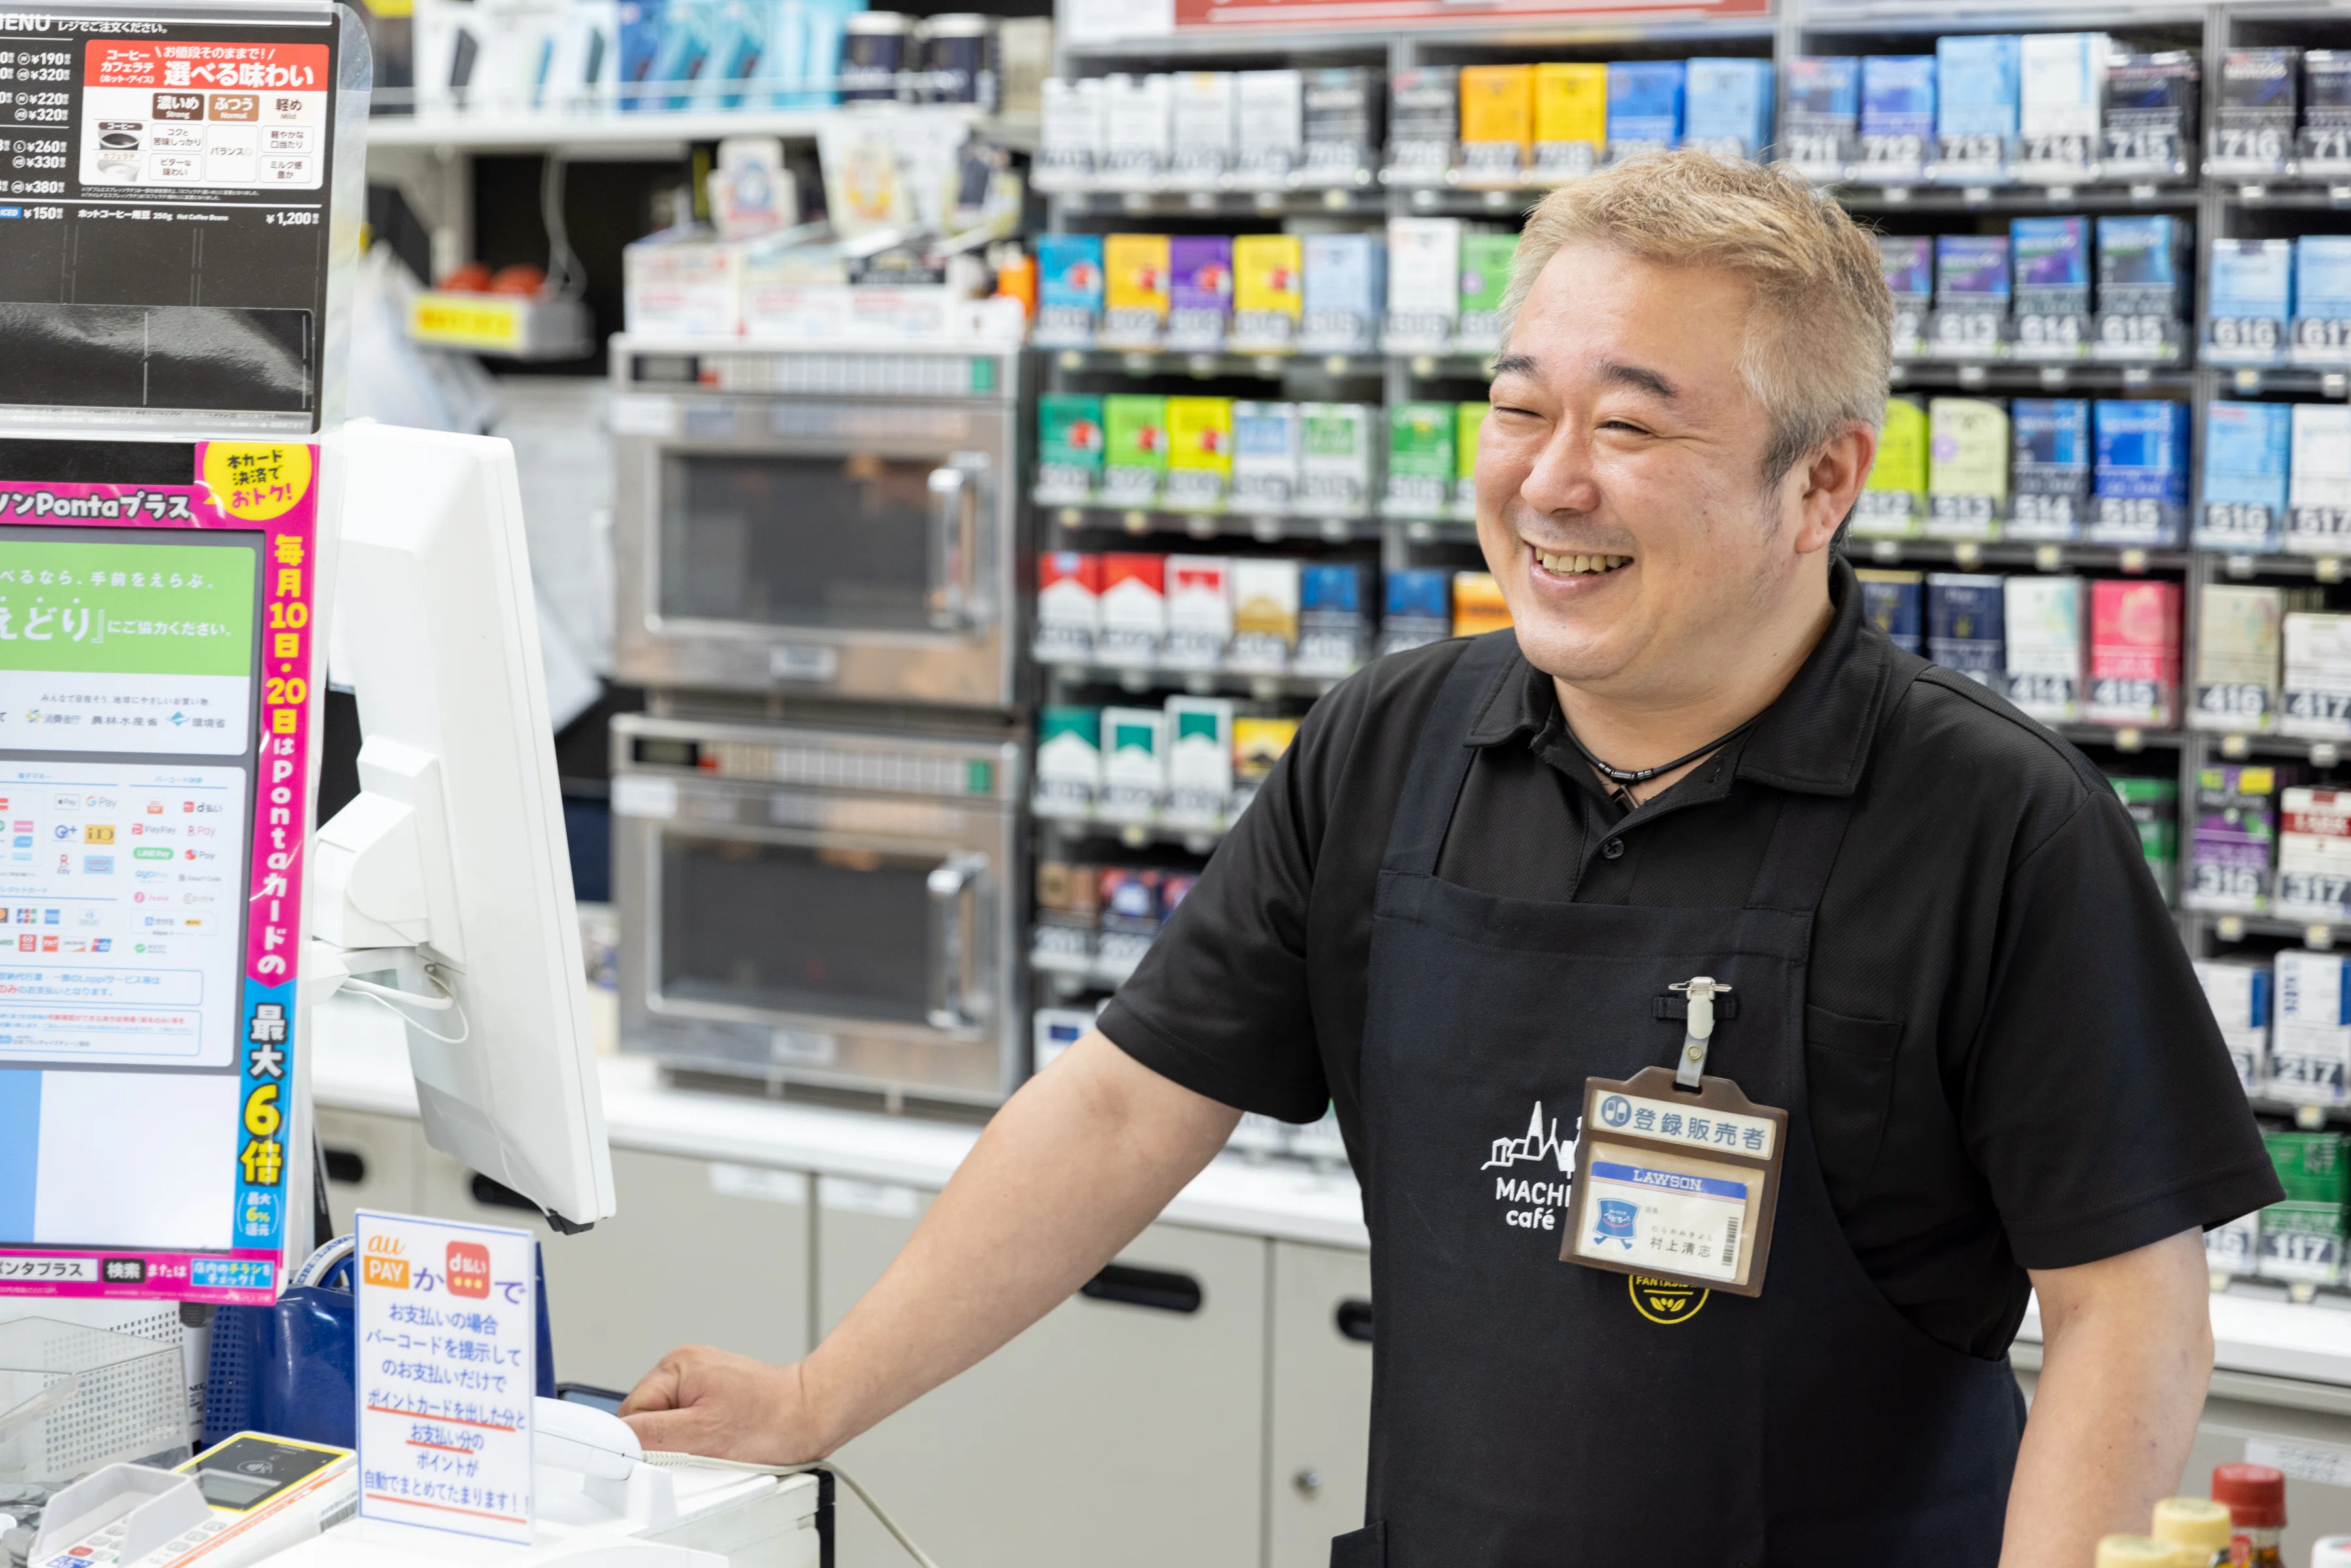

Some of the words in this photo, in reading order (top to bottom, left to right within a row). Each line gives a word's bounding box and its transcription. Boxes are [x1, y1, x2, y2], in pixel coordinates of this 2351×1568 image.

[57, 20, 168, 34] レジでご注文ください。
[106, 50, 150, 61] コーヒー
[101, 61, 155, 72] カフェラテ
[163, 62, 314, 88] 選べる味わい
[157, 95, 200, 110] 濃いめ
[214, 97, 253, 111] ふつう
[276, 98, 302, 112] 軽め
[166, 110, 191, 119] Strong
[270, 140, 303, 149] 口当たり
[271, 130, 304, 139] 軽やかな
[2113, 132, 2170, 159] 715
[2224, 130, 2282, 161] 716
[2313, 131, 2351, 159] 71
[161, 158, 191, 167] ビターな
[270, 161, 303, 169] ミルク感
[277, 170, 294, 179] 豊か
[77, 209, 152, 220] ホットコーヒー用豆
[153, 212, 174, 222] 250g
[227, 449, 283, 469] 本カード
[232, 466, 281, 486] 決済で
[2202, 685, 2264, 716] 416
[2291, 690, 2350, 719] 417
[91, 715, 158, 727] 農林水産省
[191, 718, 226, 729] 環境省
[99, 796, 118, 810] Pay
[87, 827, 114, 840] iD
[144, 825, 178, 835] PayPay
[197, 825, 216, 837] Pay
[199, 850, 216, 861] Pay
[2281, 1055, 2337, 1085] 217
[239, 1003, 289, 1187] 最大6倍
[1634, 1108, 1765, 1151] 登録販売者
[1633, 1169, 1703, 1191] LAWSON
[1506, 1207, 1556, 1230] café
[1652, 1226, 1714, 1241] むらかみきよし
[368, 1234, 406, 1255] au
[1650, 1236, 1712, 1258] 村上清志
[2273, 1234, 2328, 1262] 117
[0, 1261, 83, 1277] ンタプラス
[107, 1262, 141, 1279] 検索
[148, 1264, 187, 1278] または
[369, 1260, 404, 1282] PAY
[449, 1253, 487, 1275] d払い
[389, 1303, 498, 1336] お支払いの場合
[366, 1330, 522, 1367] バーコードを提示して
[381, 1358, 507, 1393] のお支払いだけで
[368, 1389, 526, 1430] ポイントカードを出した分と
[411, 1424, 484, 1451] お支払い分の
[417, 1452, 478, 1477] ポイントが
